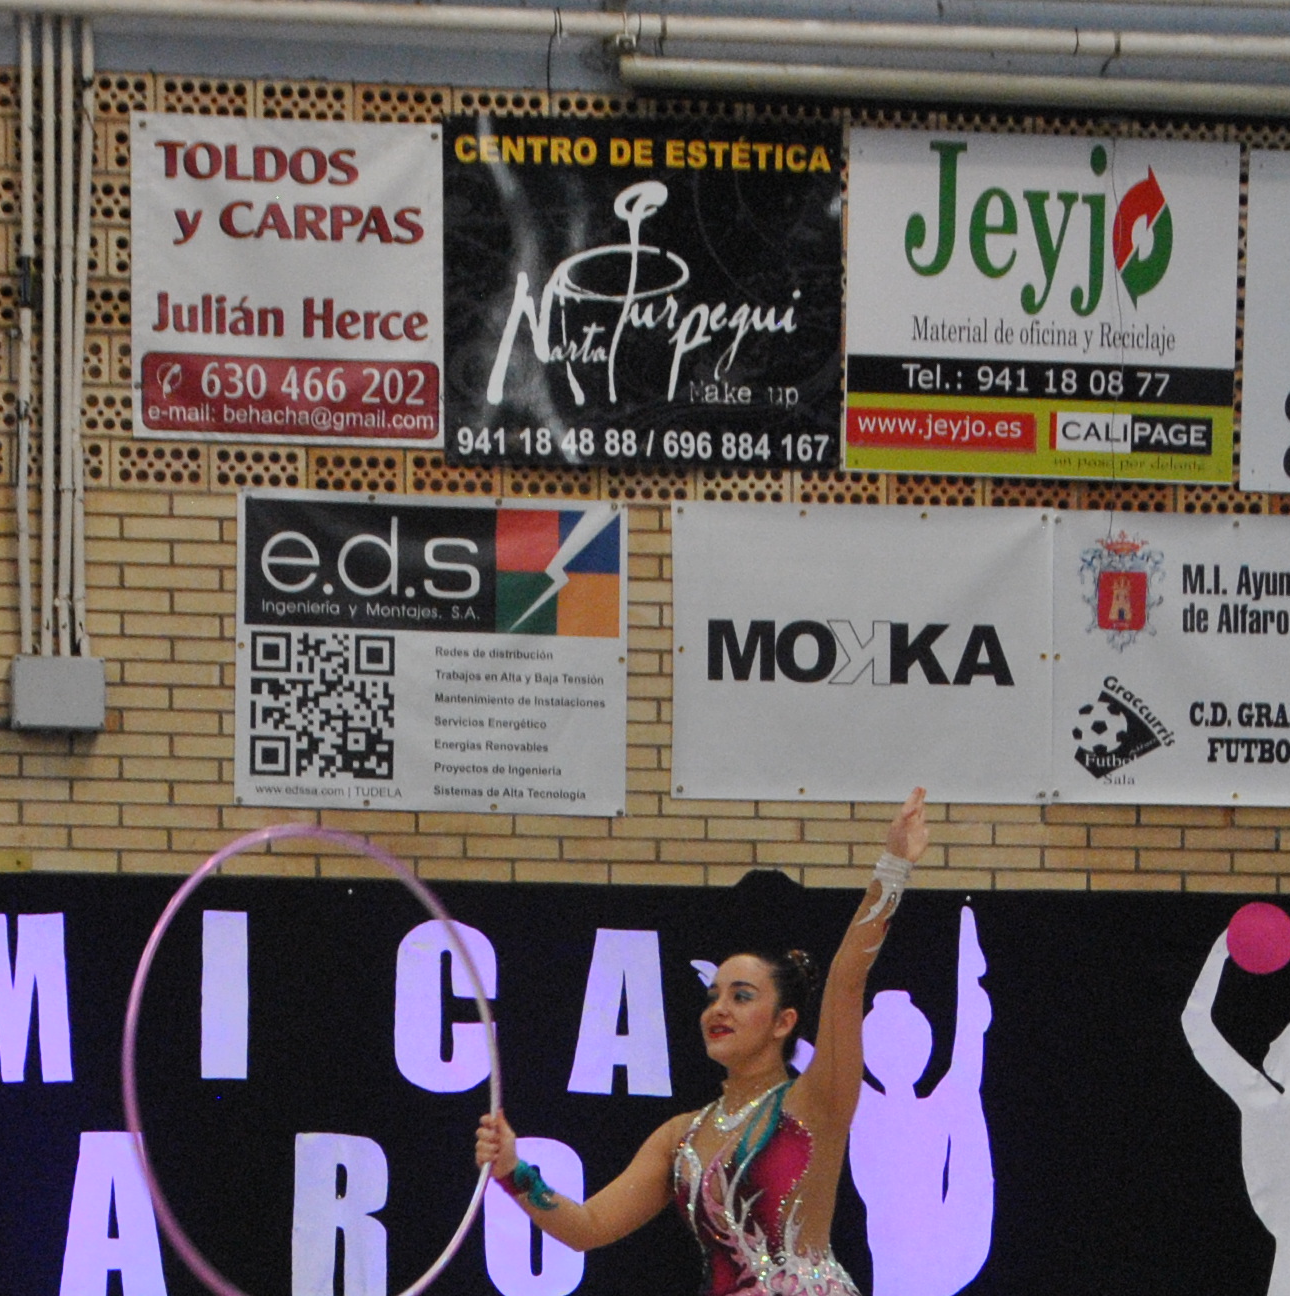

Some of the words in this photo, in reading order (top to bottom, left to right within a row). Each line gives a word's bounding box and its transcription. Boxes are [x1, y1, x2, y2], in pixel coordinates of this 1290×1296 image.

[154, 140, 359, 186] TOLDOS
[454, 134, 598, 167] CENTRO
[609, 137, 654, 167] DE
[665, 135, 832, 174] ESTÉTICA
[172, 208, 203, 246] y
[218, 200, 425, 245] CARPAS
[151, 291, 285, 337] Julián
[302, 297, 429, 342] Herce
[911, 315, 988, 345] Material
[994, 318, 1015, 346] de
[1019, 320, 1078, 348] oficina
[1082, 330, 1094, 354] y
[1099, 321, 1176, 357] Reciclaje
[200, 361, 267, 400] 630
[280, 365, 347, 402] 466
[361, 367, 426, 406] 202
[977, 365, 1029, 393] 941
[1044, 368, 1077, 395] 18
[1089, 369, 1124, 397] 08
[1136, 372, 1171, 398] 77
[767, 385, 799, 410] up
[147, 404, 216, 424] e-mail:
[222, 403, 435, 431] behacha@gmail.com
[857, 413, 1023, 442] www.jeyjo.es
[1060, 419, 1207, 447] CALIPAGE
[457, 425, 505, 456] 941
[519, 427, 552, 456] 18
[560, 428, 595, 457] 48
[604, 428, 638, 458] 88
[646, 429, 656, 457] /
[663, 430, 713, 460] 696
[721, 432, 771, 461] 884
[781, 433, 831, 462] 167
[260, 515, 482, 600] e.d.s
[1182, 564, 1228, 596] M.I.
[261, 599, 341, 618] Ingeniería
[348, 605, 358, 619] y
[450, 606, 482, 621] S.A.
[1182, 603, 1209, 633] de
[1217, 603, 1290, 635] Alfaro
[435, 645, 470, 658] Redes
[472, 647, 486, 659] de
[488, 648, 554, 661] distribución
[435, 669, 482, 682] Trabajos
[484, 674, 498, 682] en
[500, 672, 522, 683] Alta
[524, 675, 531, 685] y
[534, 673, 559, 686] Baja
[562, 674, 605, 686] Tensión
[434, 692, 515, 706] Mantenimiento
[517, 695, 531, 706] de
[1102, 675, 1176, 748] Graccurris
[434, 715, 485, 728] Servicios
[487, 717, 548, 732] Energético
[1188, 701, 1232, 727] C.D.
[434, 739, 482, 753] Energías
[485, 740, 549, 754] Renovables
[1085, 751, 1138, 768] Futbol
[434, 762, 489, 776] Proyectos
[492, 763, 506, 775] de
[508, 763, 562, 779] Ingeniería
[1103, 773, 1136, 786] Sala
[354, 786, 403, 799] TUDELA
[433, 785, 484, 798] Sistemas
[486, 786, 500, 798] de
[502, 787, 524, 799] Alta
[527, 788, 587, 802] Tecnología
